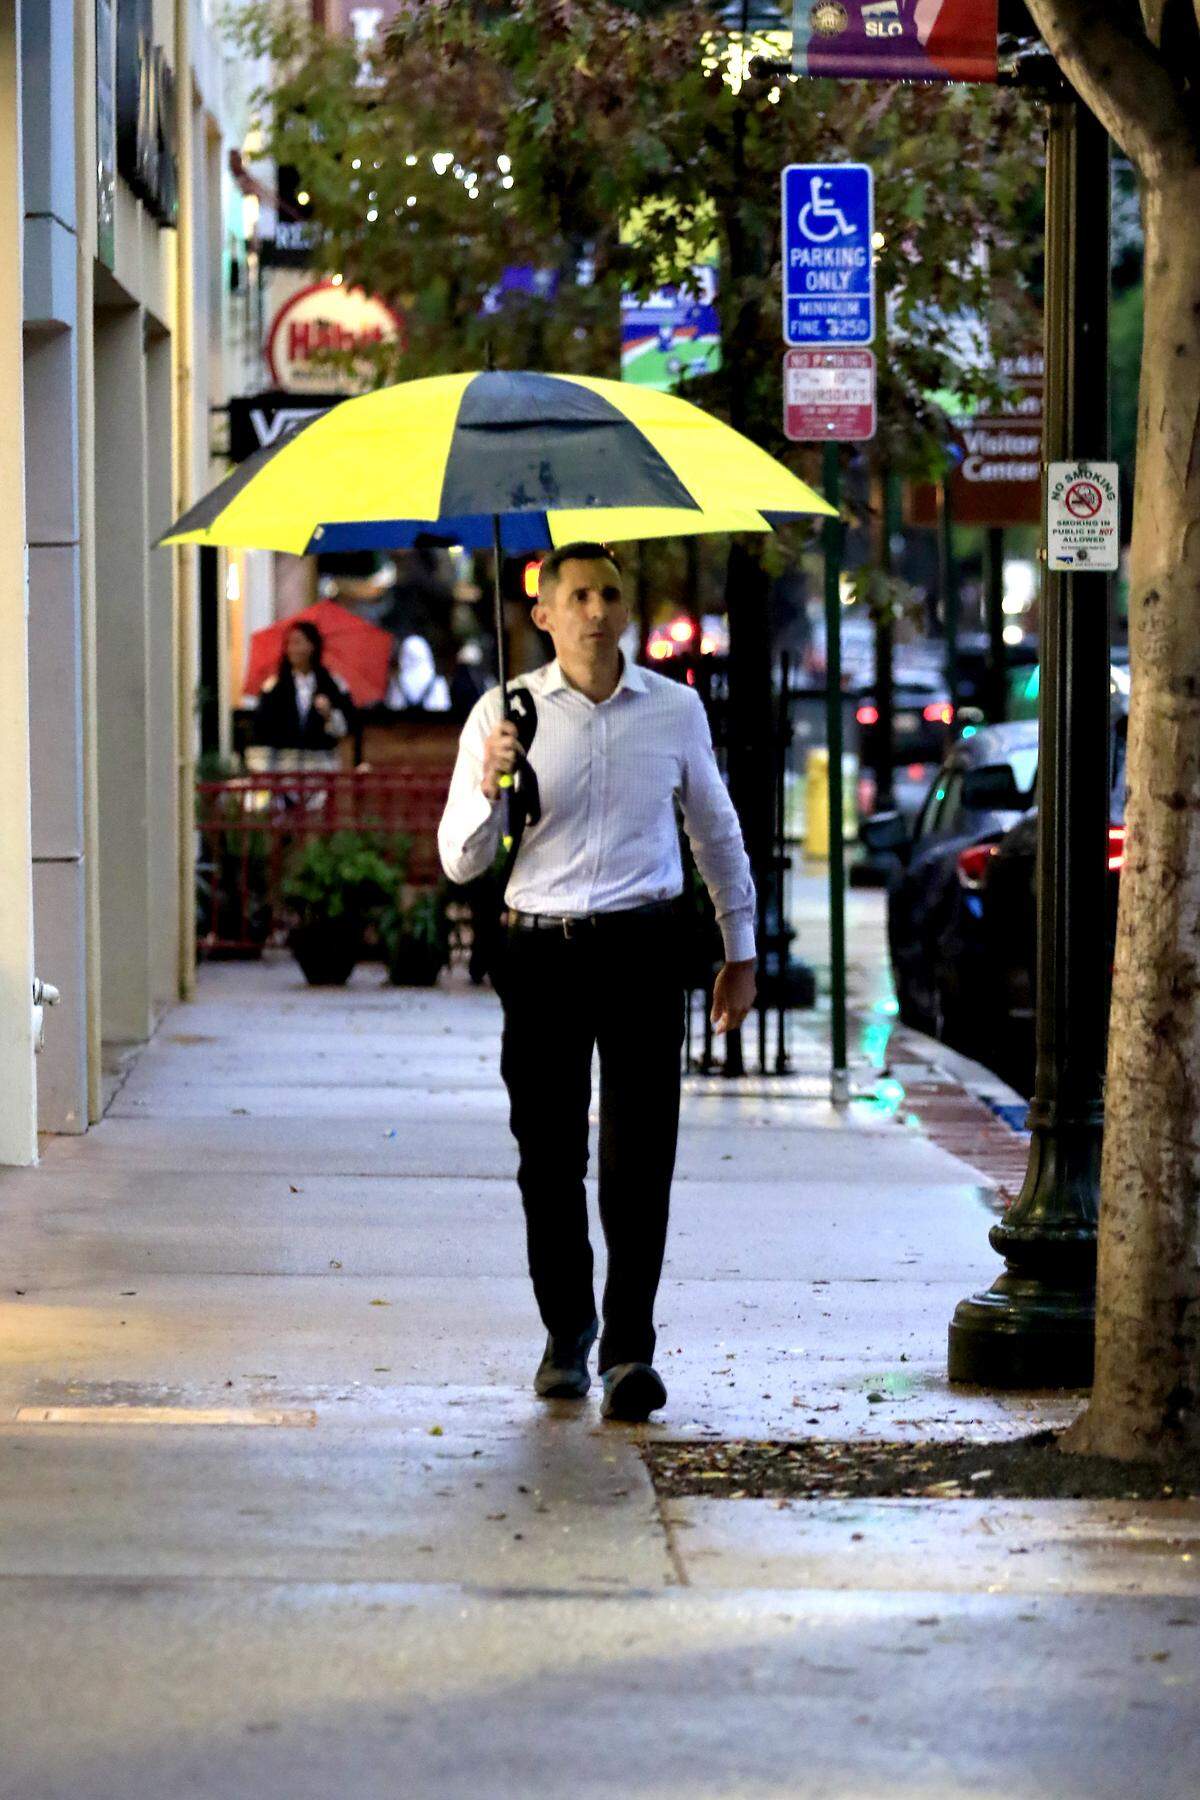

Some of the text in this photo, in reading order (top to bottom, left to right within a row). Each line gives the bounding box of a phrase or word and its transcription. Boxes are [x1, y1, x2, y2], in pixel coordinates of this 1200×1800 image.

[865, 20, 903, 38] SLO
[790, 247, 867, 269] PARKING
[806, 270, 852, 292] ONLY
[799, 302, 860, 317] MINIMUM
[790, 319, 821, 336] FINE
[812, 353, 869, 369] PRKING
[963, 430, 1040, 456] Visitor
[962, 455, 1040, 481] Center
[1051, 469, 1116, 502] NO SMOKING
[1052, 528, 1085, 536] PUBLIC
[1098, 527, 1114, 536] NOT
[1056, 519, 1110, 527] SMOKING IN
